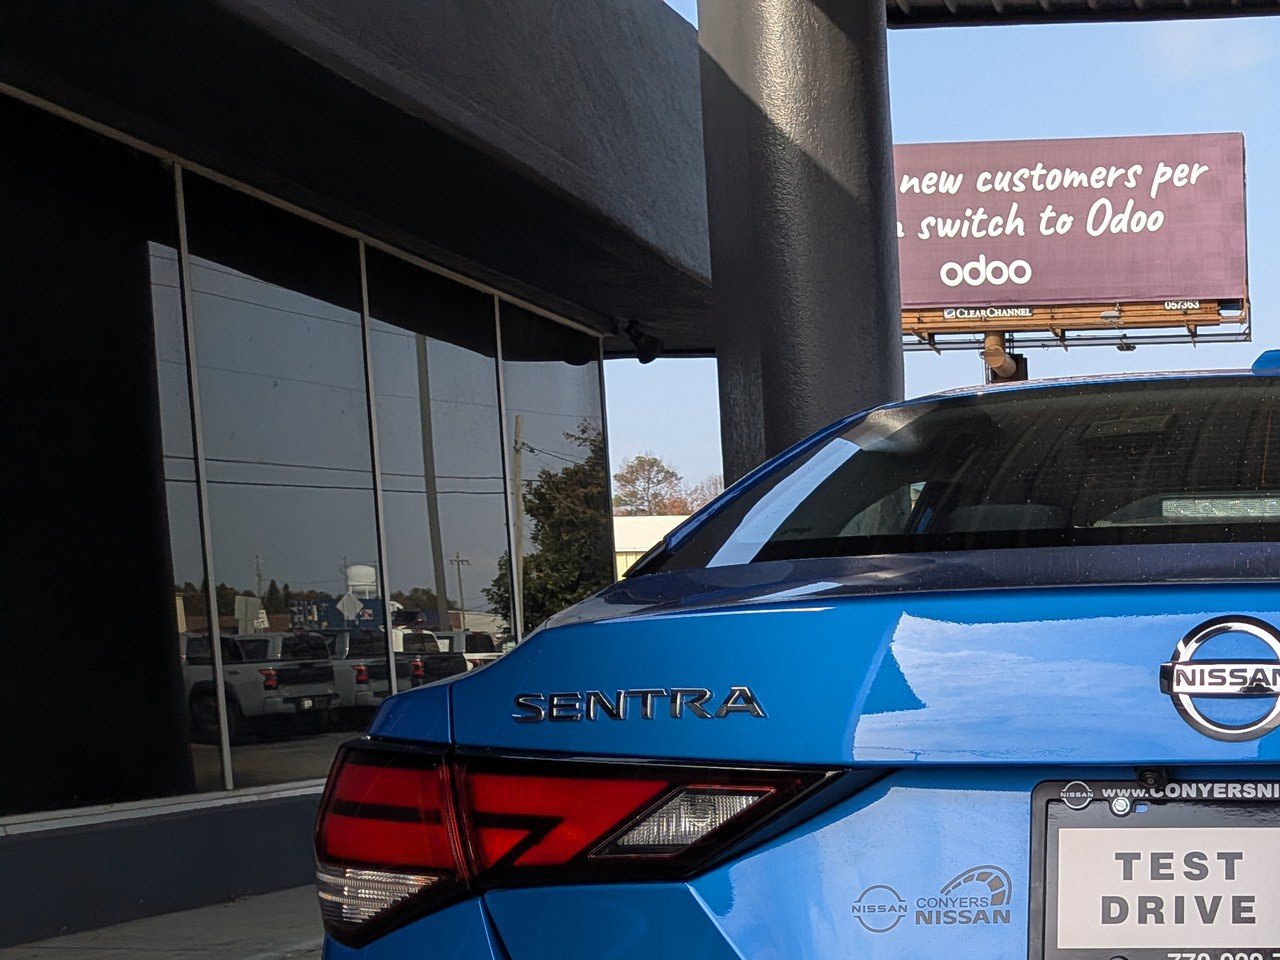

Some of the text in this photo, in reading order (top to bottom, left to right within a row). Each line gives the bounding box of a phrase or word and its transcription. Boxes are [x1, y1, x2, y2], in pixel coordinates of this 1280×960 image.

[899, 162, 1209, 199] new customers per
[917, 202, 1025, 240] switch
[1039, 204, 1074, 236] to
[1086, 197, 1164, 237] Odoo
[940, 253, 1032, 287] odoo
[512, 686, 769, 722] SENTRA
[1114, 851, 1243, 881] TEST
[851, 904, 908, 913] NISSAN
[915, 909, 1011, 925] NISSAN
[916, 897, 989, 908] CONYERS
[1101, 895, 1256, 924] DRIVE
